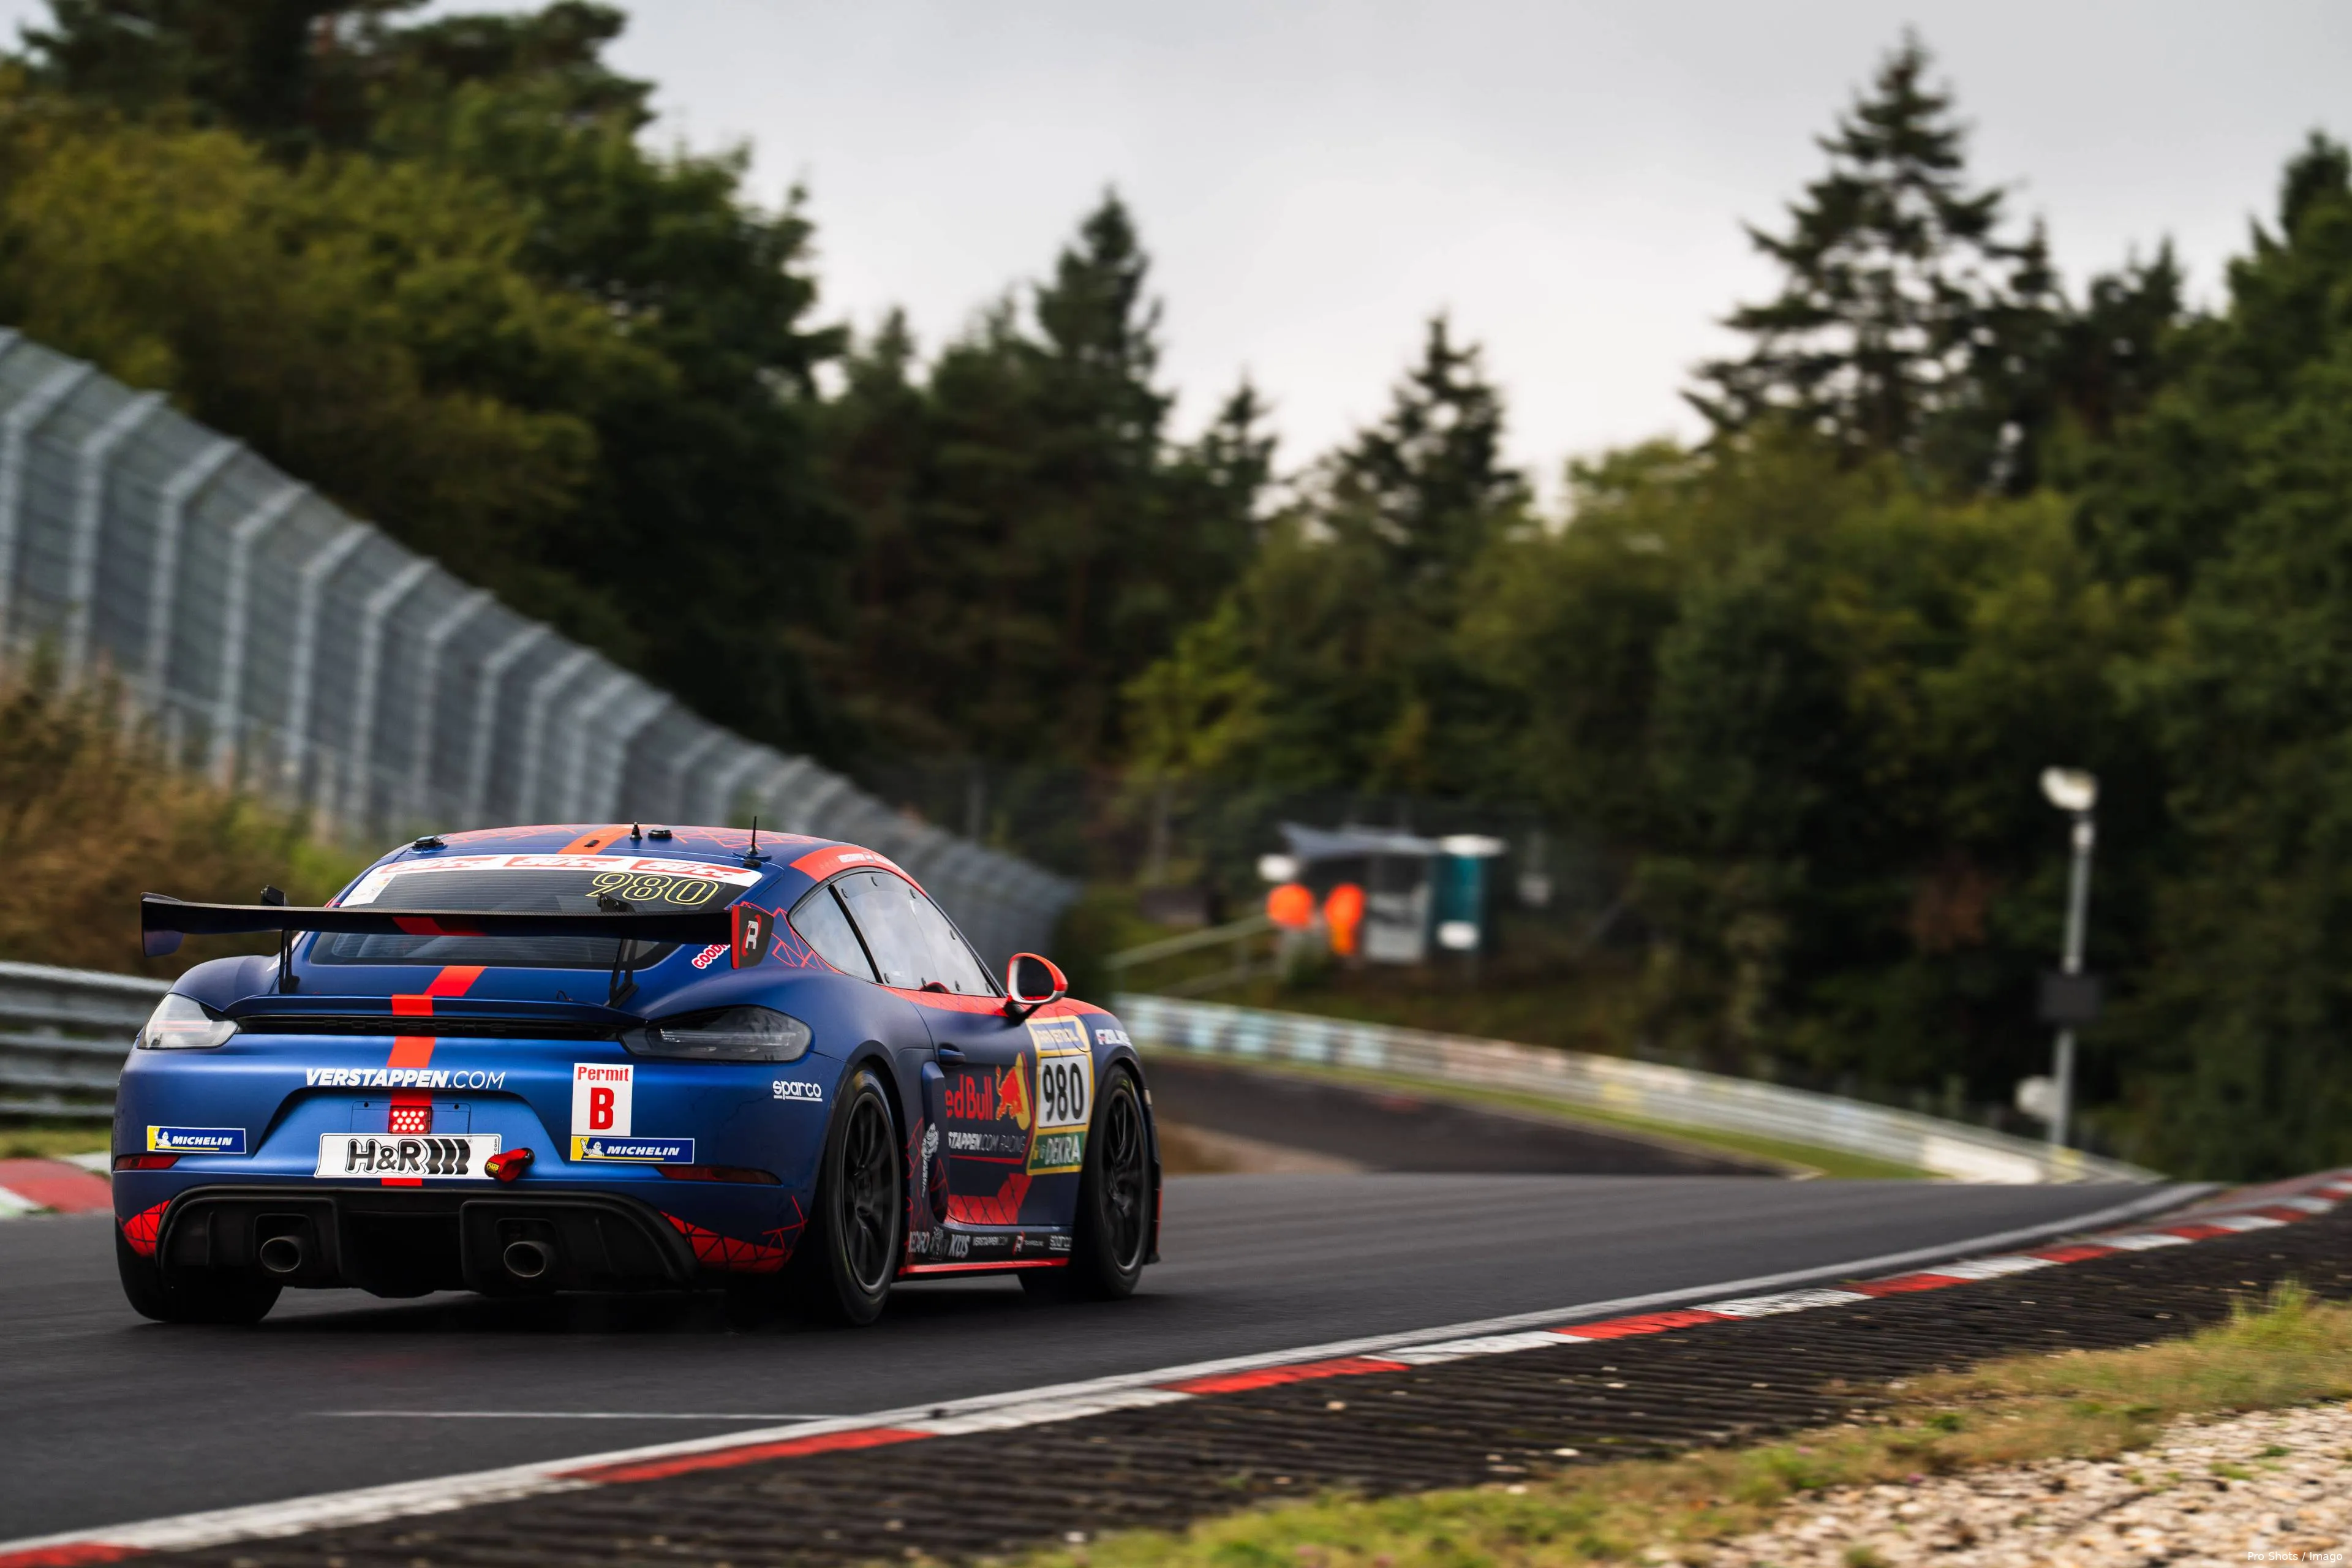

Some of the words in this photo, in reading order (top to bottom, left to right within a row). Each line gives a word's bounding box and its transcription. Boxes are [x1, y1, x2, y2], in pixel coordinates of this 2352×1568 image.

[585, 872, 718, 905] 980
[324, 1020, 506, 1032] PORSCHE
[306, 1068, 507, 1089] VERSTAPPEN.COM
[578, 1066, 629, 1081] Permit
[772, 1080, 822, 1100] sparco
[945, 1074, 965, 1118] ed
[965, 1076, 993, 1120] Bull
[1043, 1063, 1084, 1121] 980
[590, 1087, 614, 1129] B
[172, 1136, 233, 1146] MICHELIN
[606, 1146, 680, 1156] MICHELIN
[948, 1131, 999, 1151] STAPPEN.COM
[1045, 1134, 1081, 1165] DEKRA
[346, 1139, 425, 1174] H&R
[486, 1163, 499, 1173] OMP
